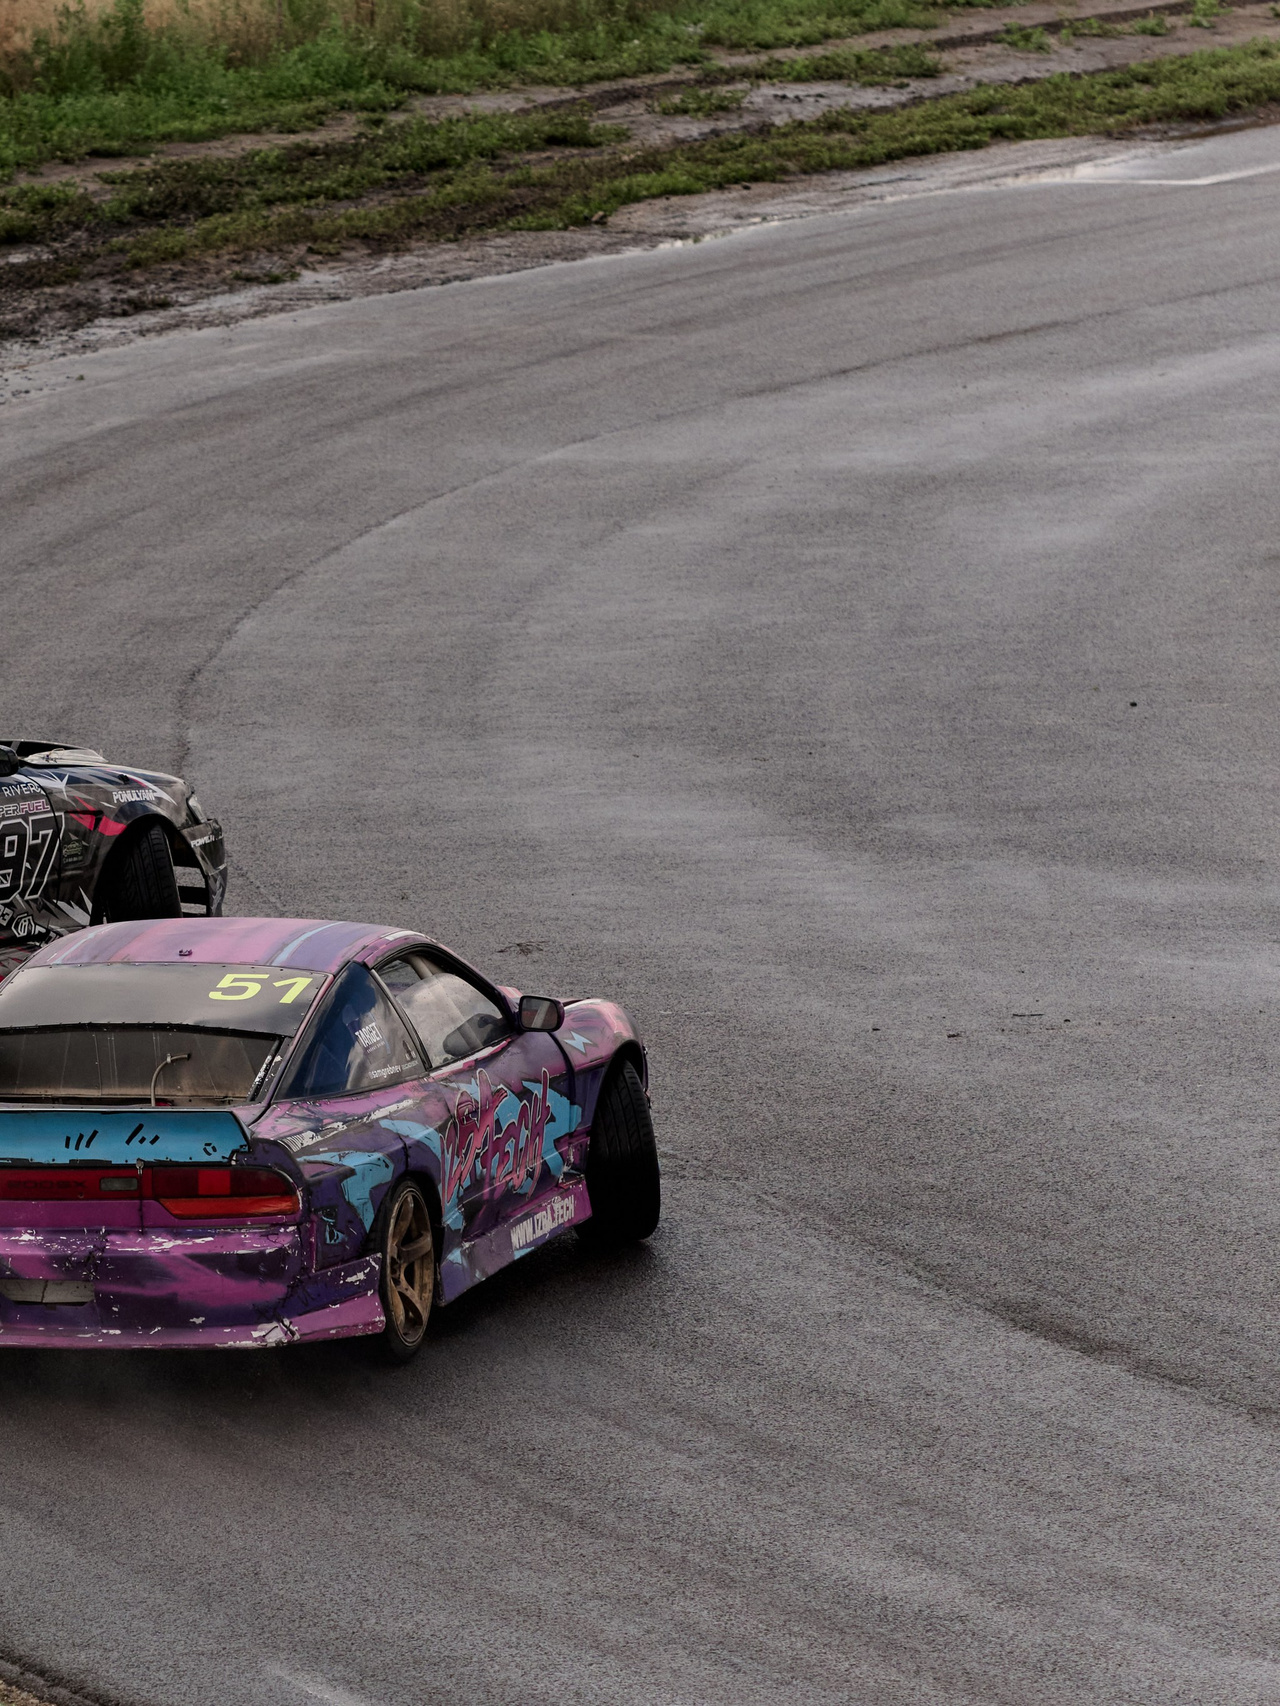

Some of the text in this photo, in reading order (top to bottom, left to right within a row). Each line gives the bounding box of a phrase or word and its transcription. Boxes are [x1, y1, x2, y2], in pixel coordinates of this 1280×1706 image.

[112, 789, 155, 804] PONULYAM
[208, 973, 313, 1004] 51
[354, 1022, 383, 1048] TARGET
